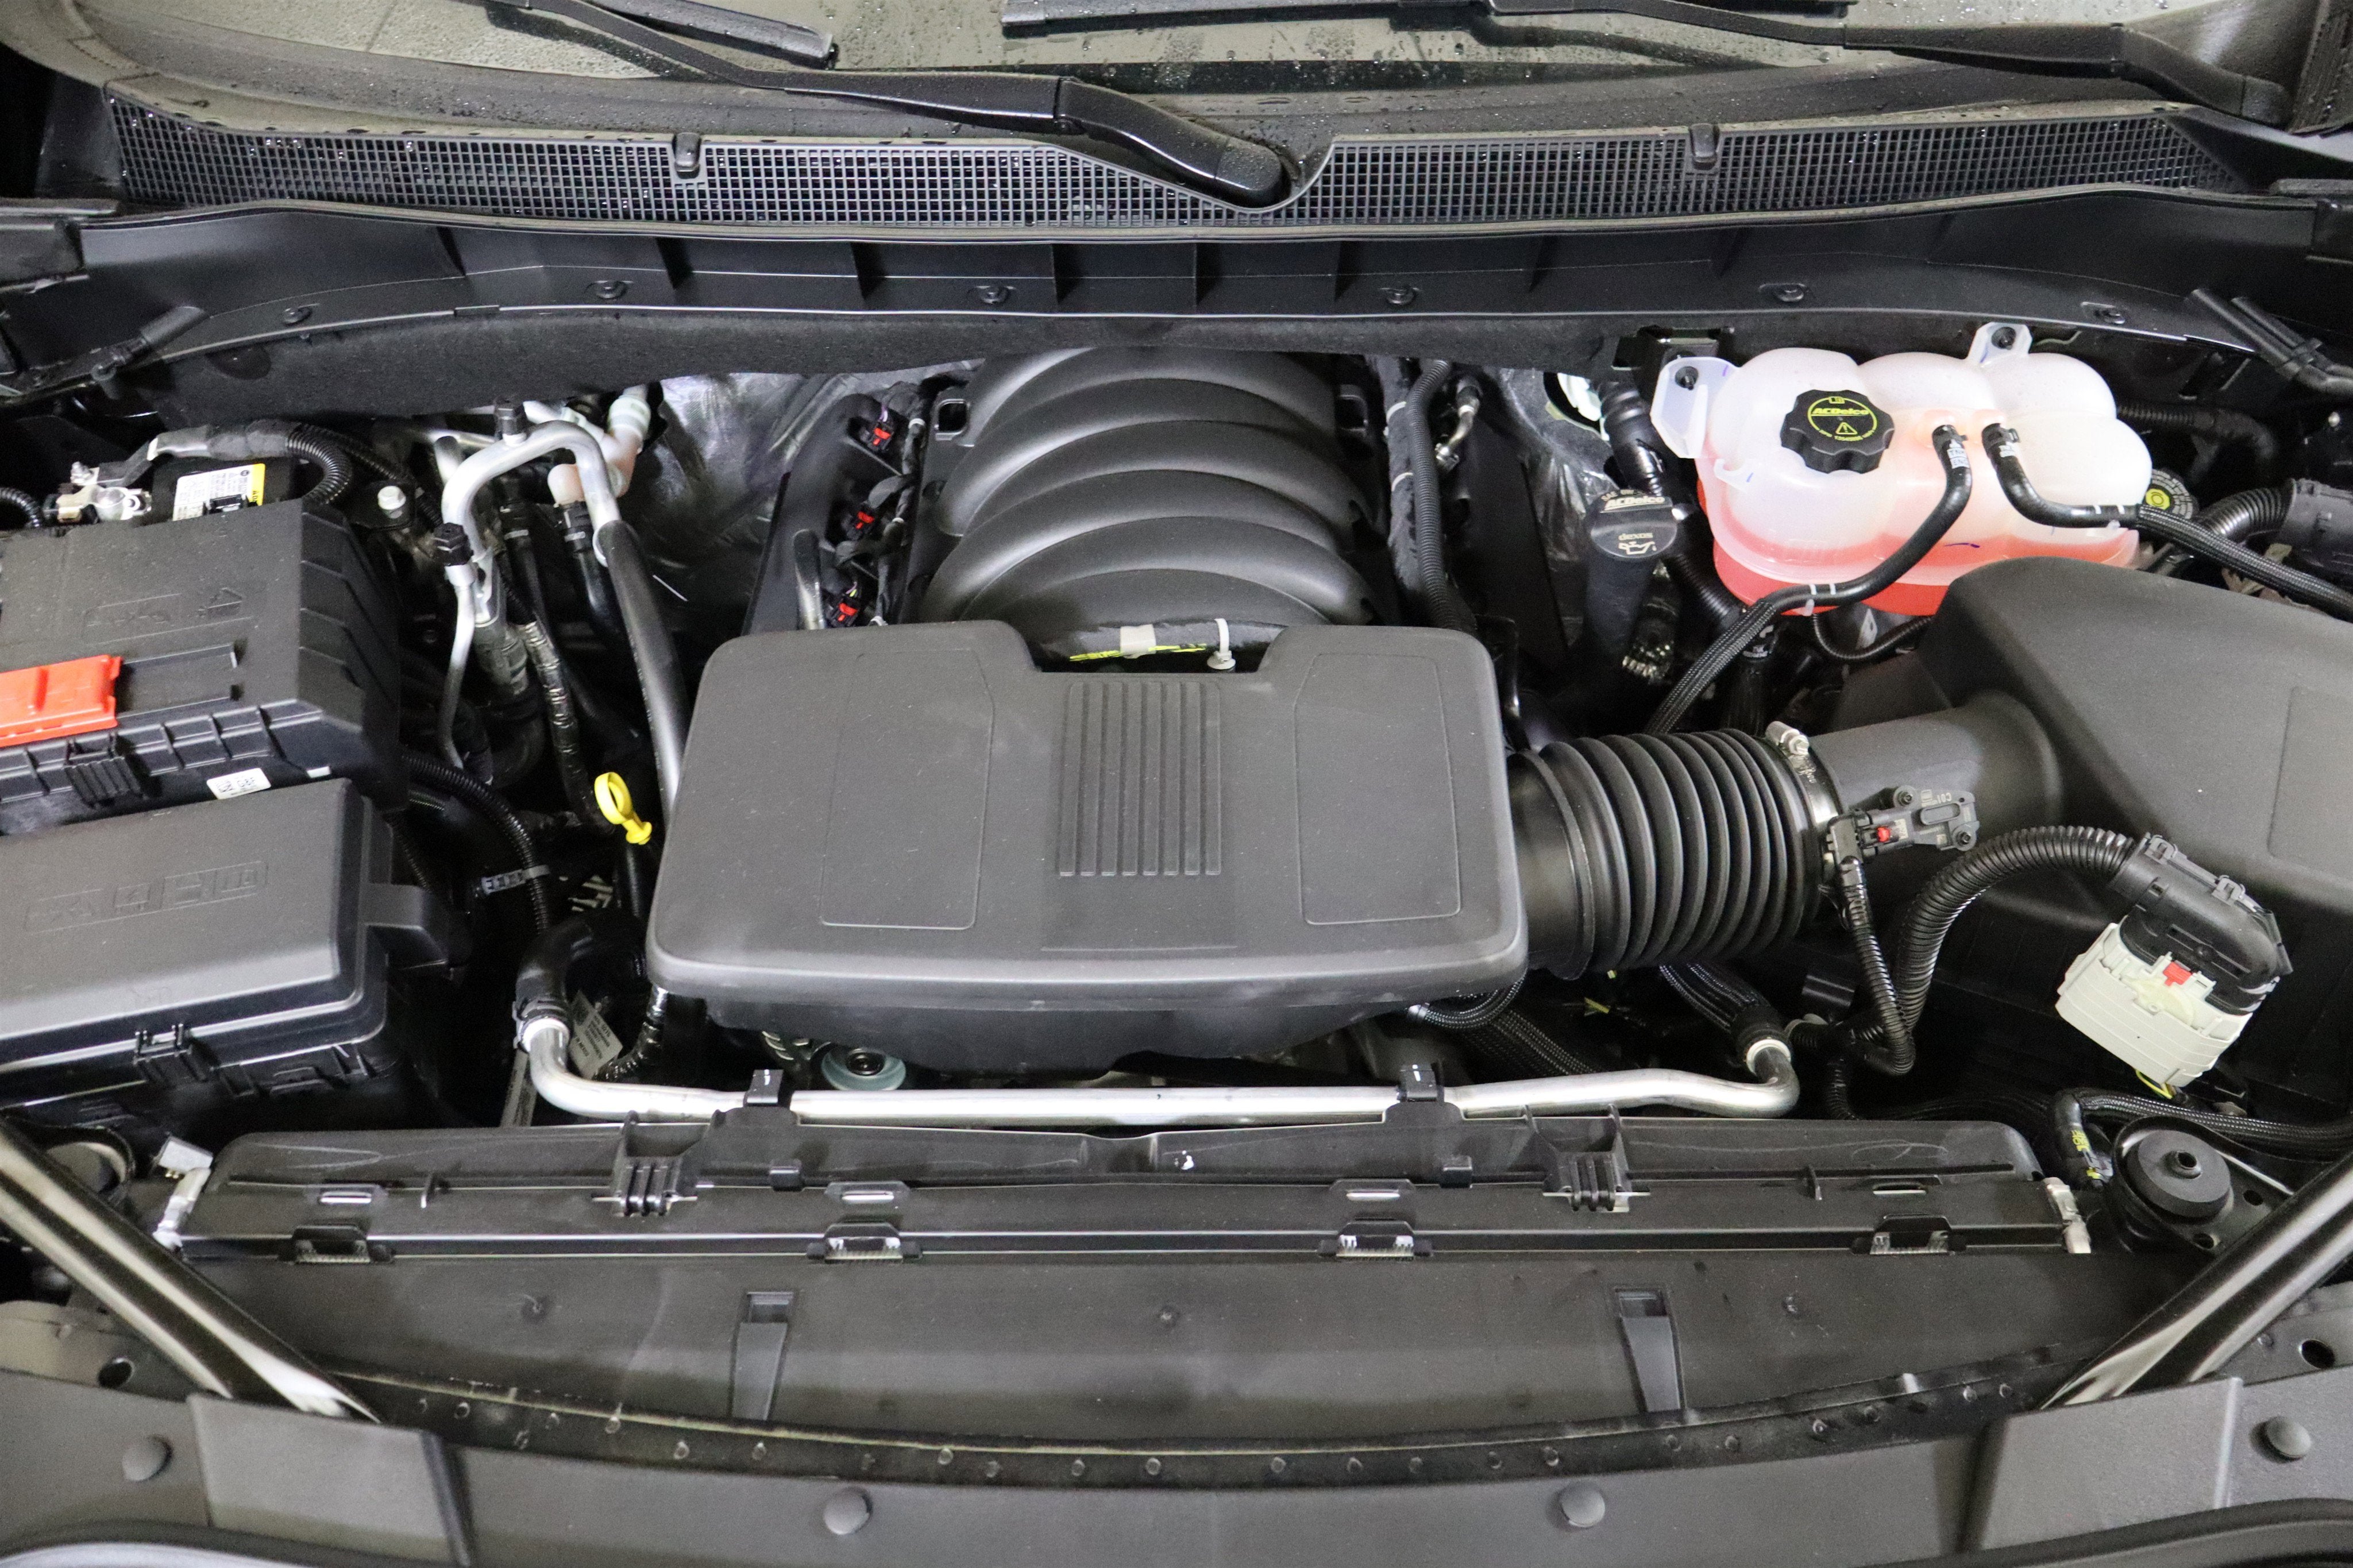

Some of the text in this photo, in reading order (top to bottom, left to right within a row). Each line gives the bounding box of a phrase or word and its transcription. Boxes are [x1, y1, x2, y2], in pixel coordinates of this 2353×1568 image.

[1812, 407, 1870, 415] ACDelco
[1600, 491, 1618, 501] SAE
[1605, 495, 1666, 509] ACDelco
[1618, 532, 1654, 540] dexos
